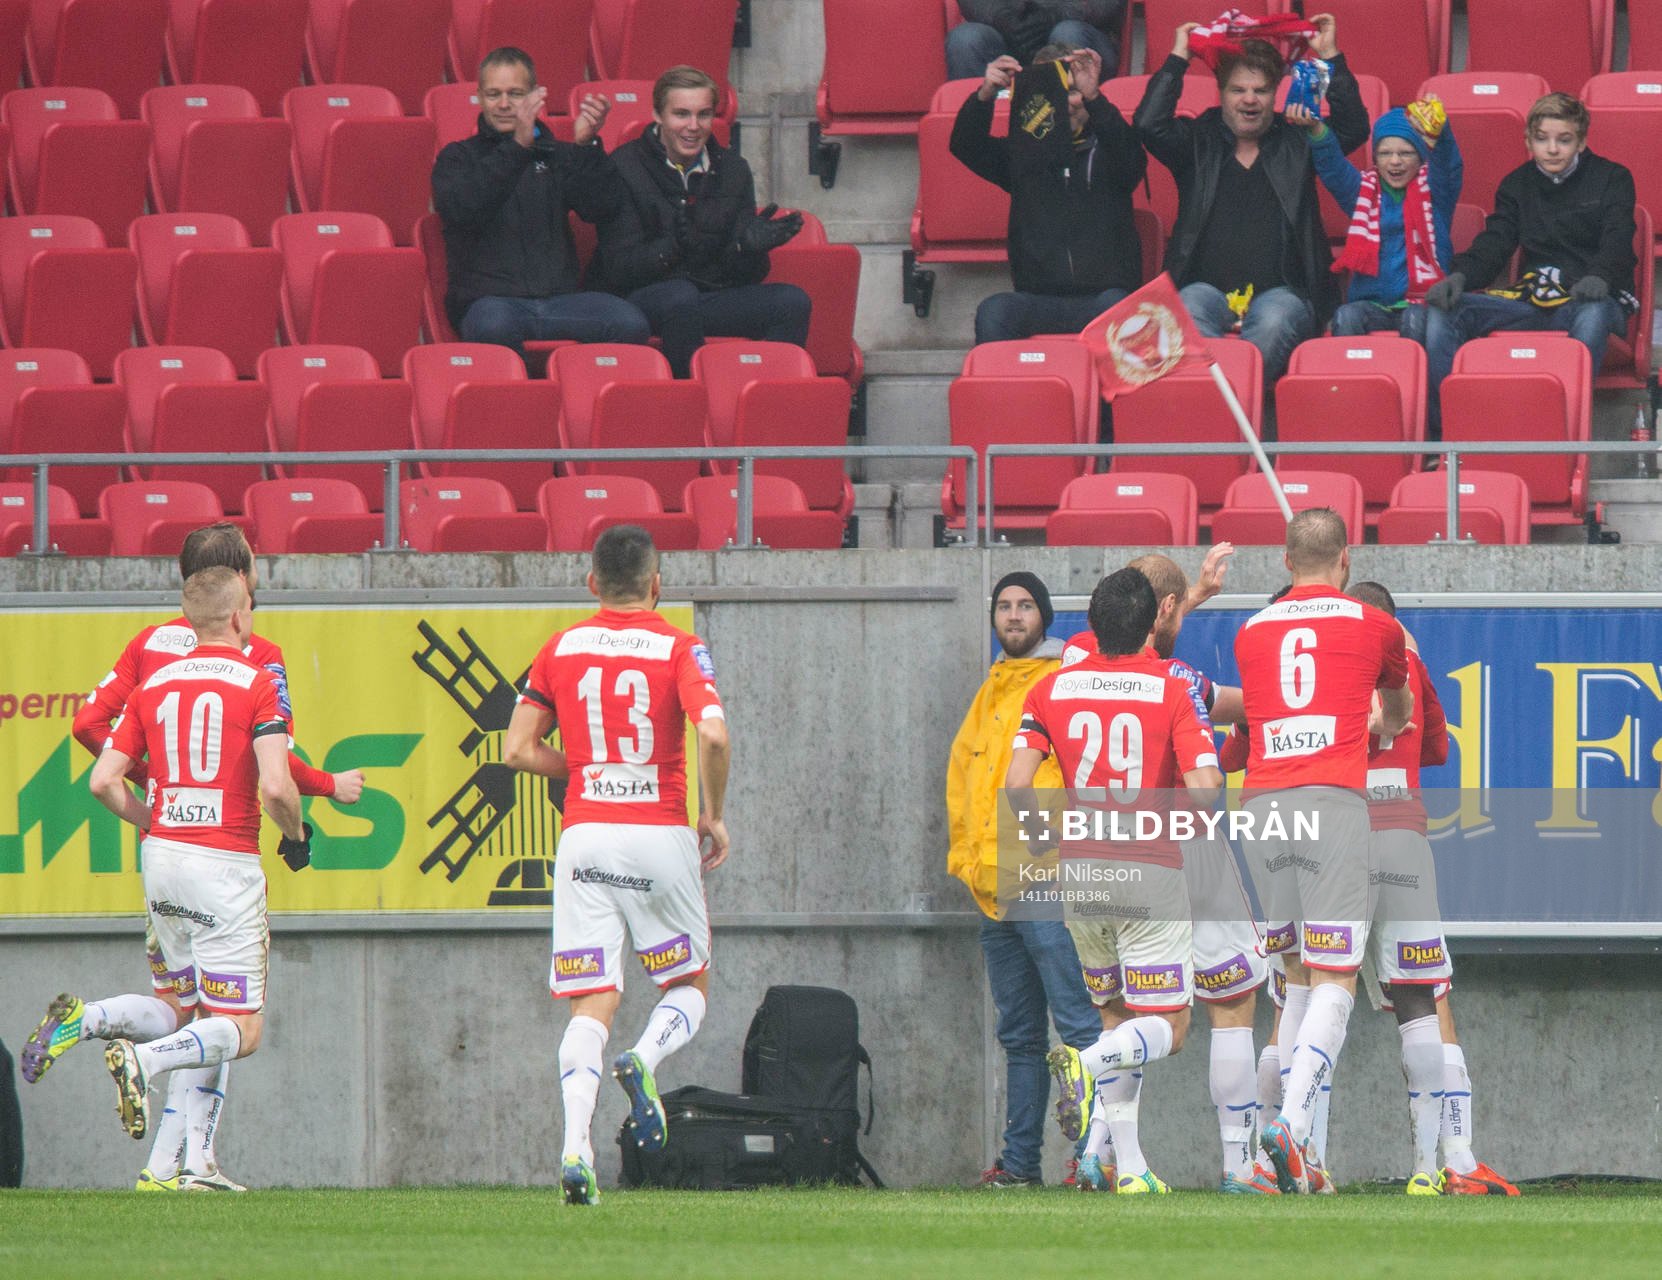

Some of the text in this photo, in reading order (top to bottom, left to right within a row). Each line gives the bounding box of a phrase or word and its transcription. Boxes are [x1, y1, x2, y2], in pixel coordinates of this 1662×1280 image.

[1056, 677, 1162, 693] RoyalDesign.se
[1280, 627, 1317, 710] 6
[156, 691, 223, 783] 10
[577, 666, 654, 764] 13
[1068, 711, 1143, 804] 29
[1271, 731, 1329, 754] RASTA
[166, 805, 217, 822] RASTA
[593, 780, 653, 796] RASTA
